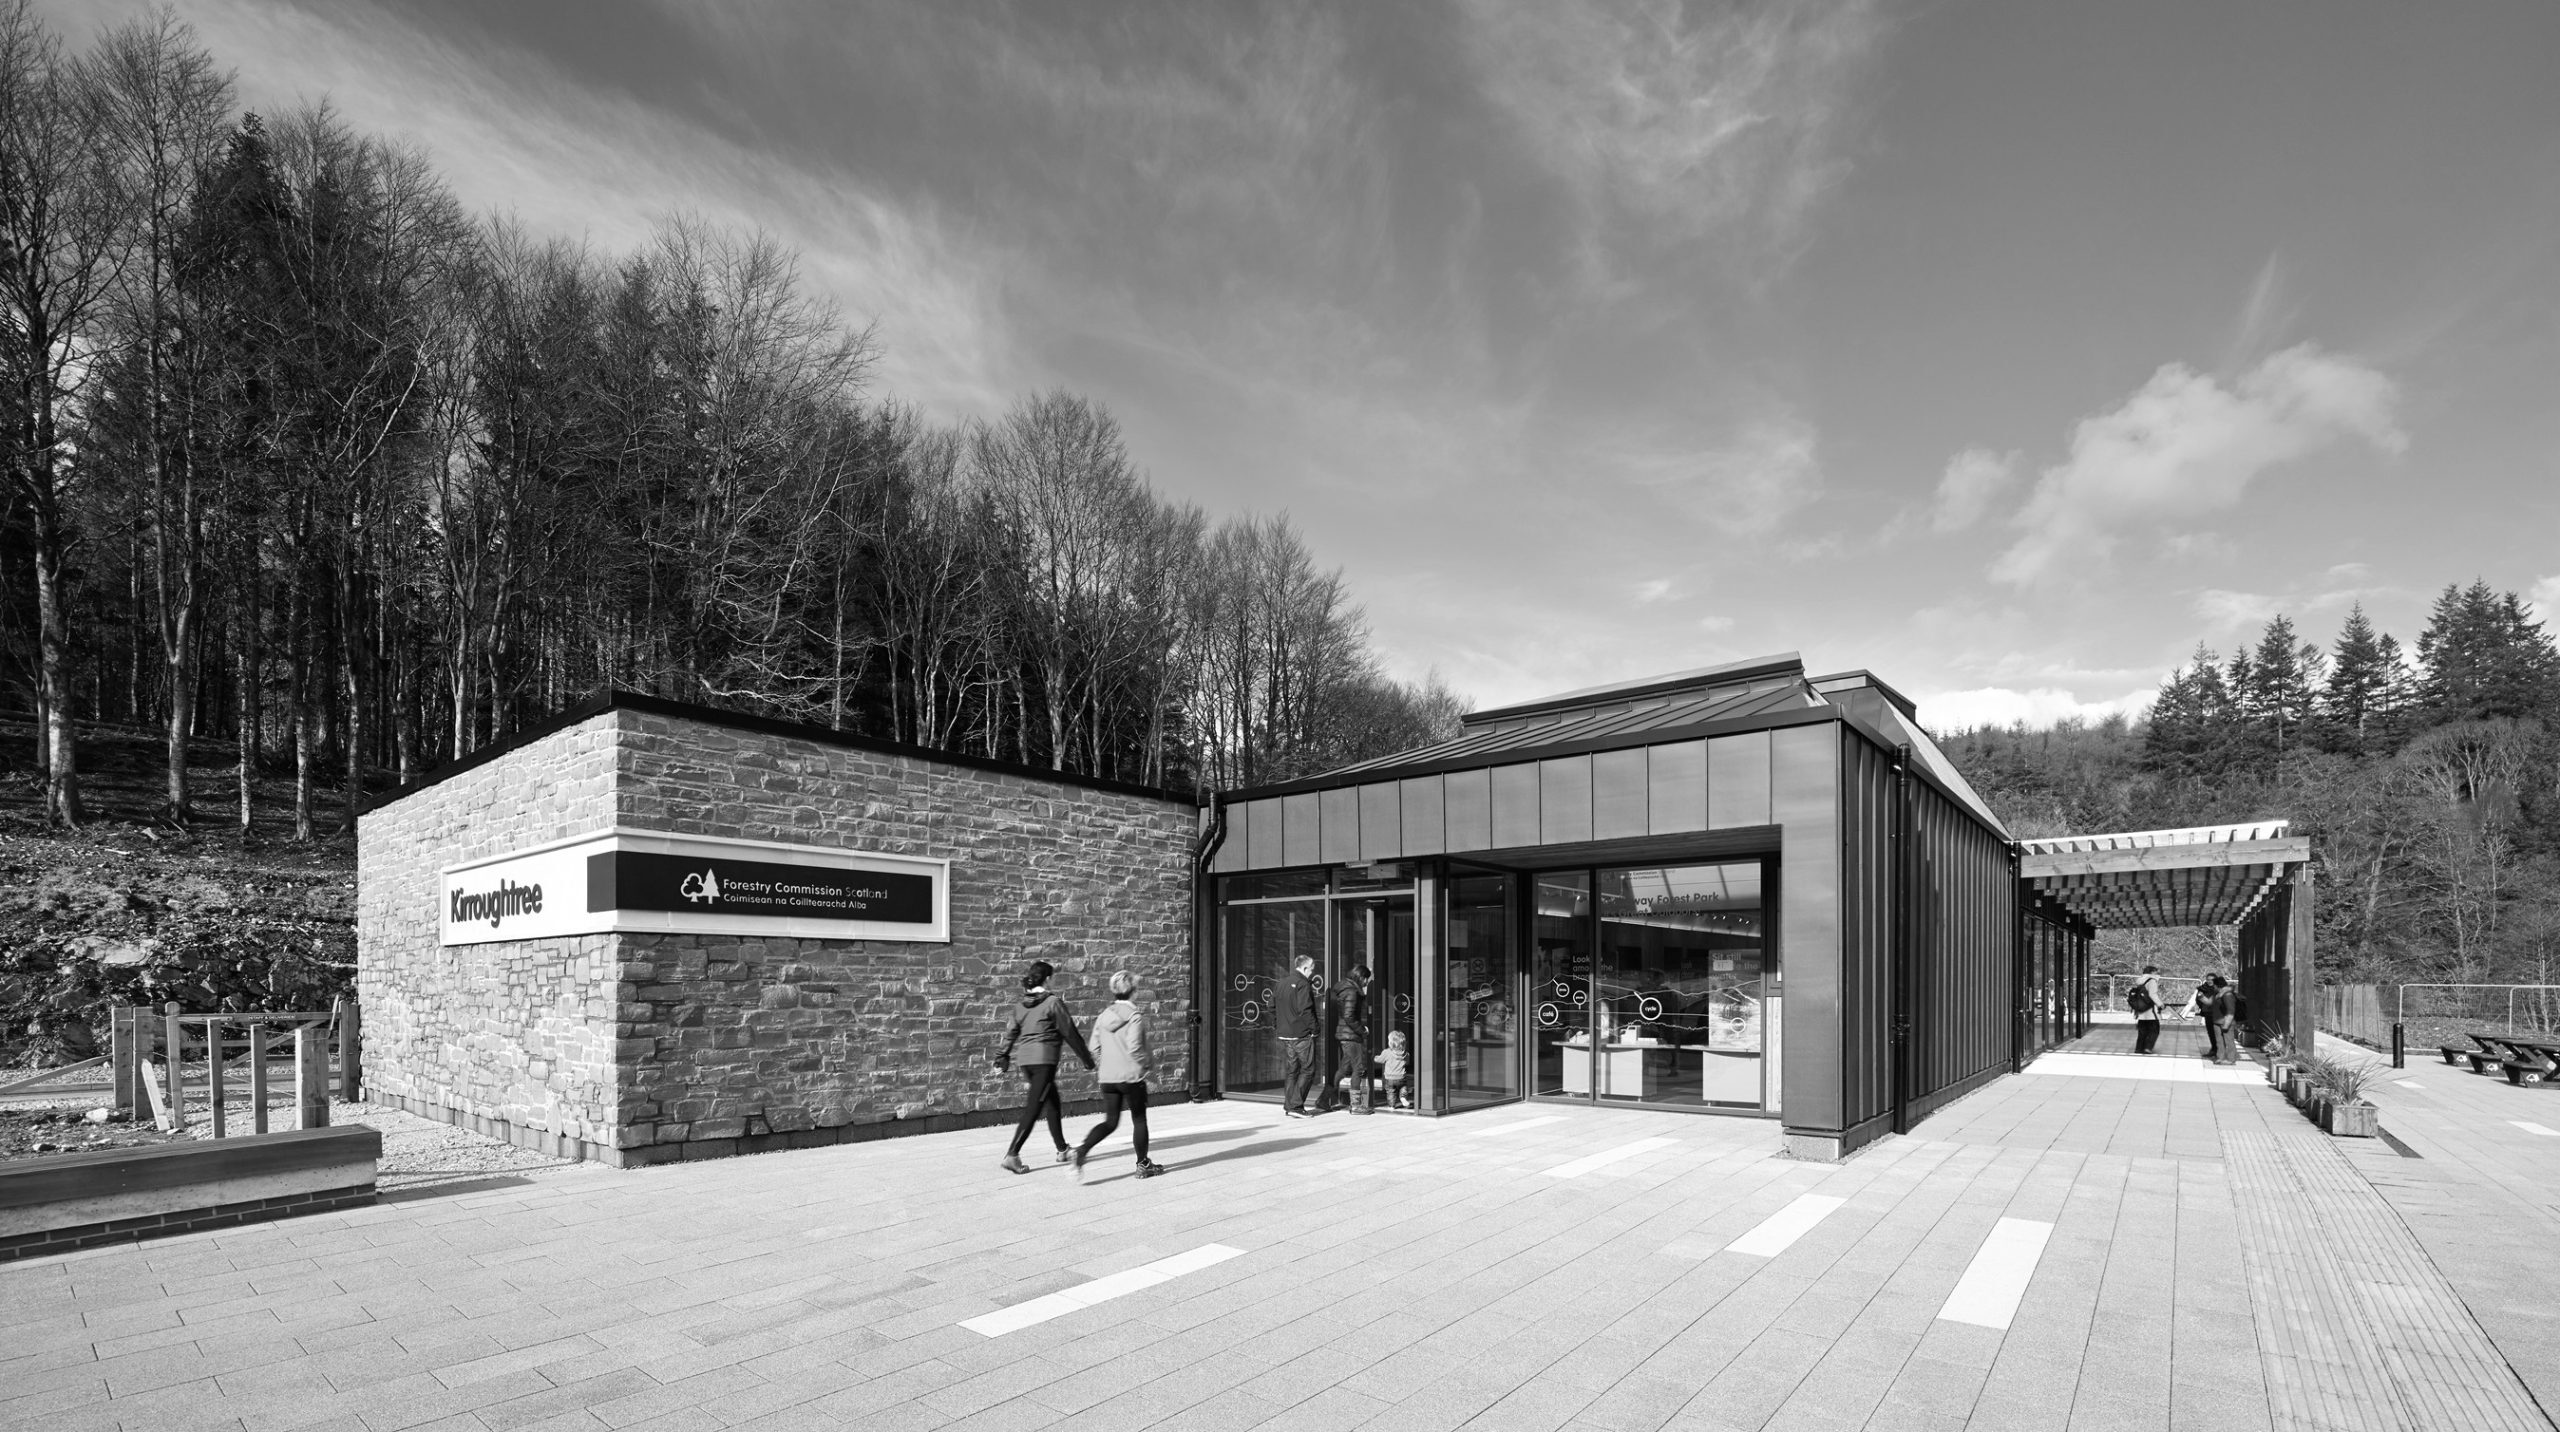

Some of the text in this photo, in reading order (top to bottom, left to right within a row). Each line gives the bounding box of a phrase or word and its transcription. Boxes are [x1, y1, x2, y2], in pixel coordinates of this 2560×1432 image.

[723, 879, 888, 899] Forestry Commission Scotland
[1693, 892, 1720, 903] Park
[451, 878, 543, 928] Kirroughtree
[723, 893, 773, 904] Coimisean
[775, 896, 787, 905] na
[849, 900, 867, 910] Alba
